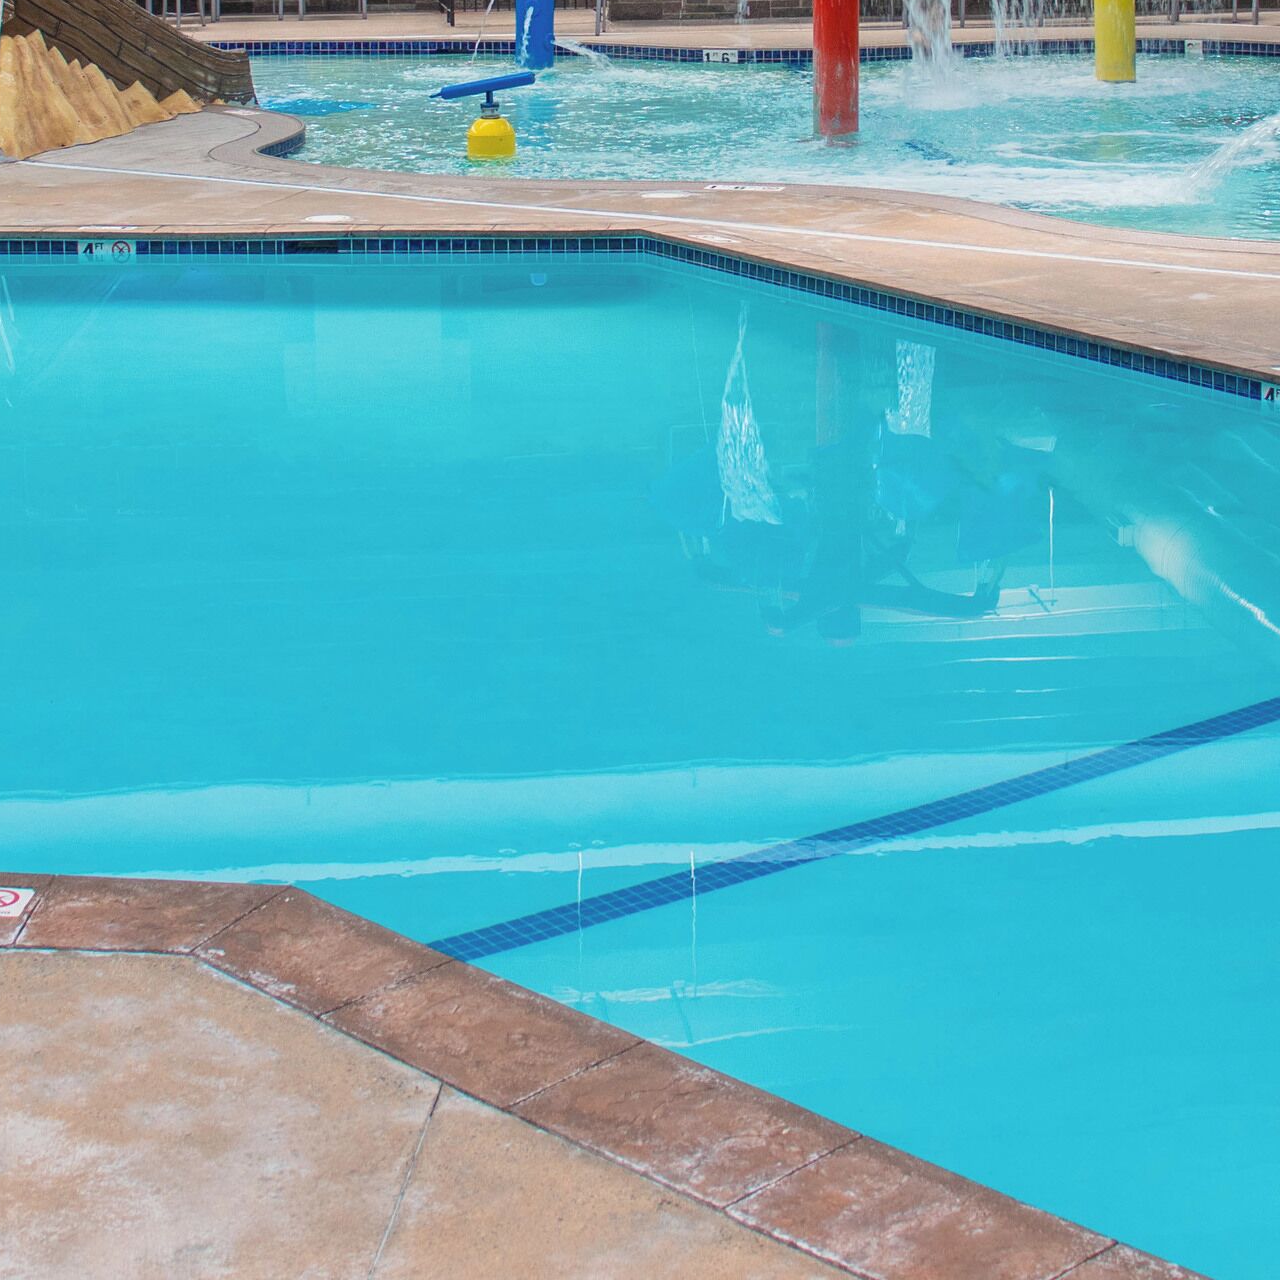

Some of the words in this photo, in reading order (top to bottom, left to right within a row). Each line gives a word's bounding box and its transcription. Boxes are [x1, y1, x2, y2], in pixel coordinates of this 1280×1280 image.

[705, 52, 711, 62] 1
[721, 52, 730, 63] 6
[94, 242, 104, 250] FT
[1264, 387, 1275, 401] 4
